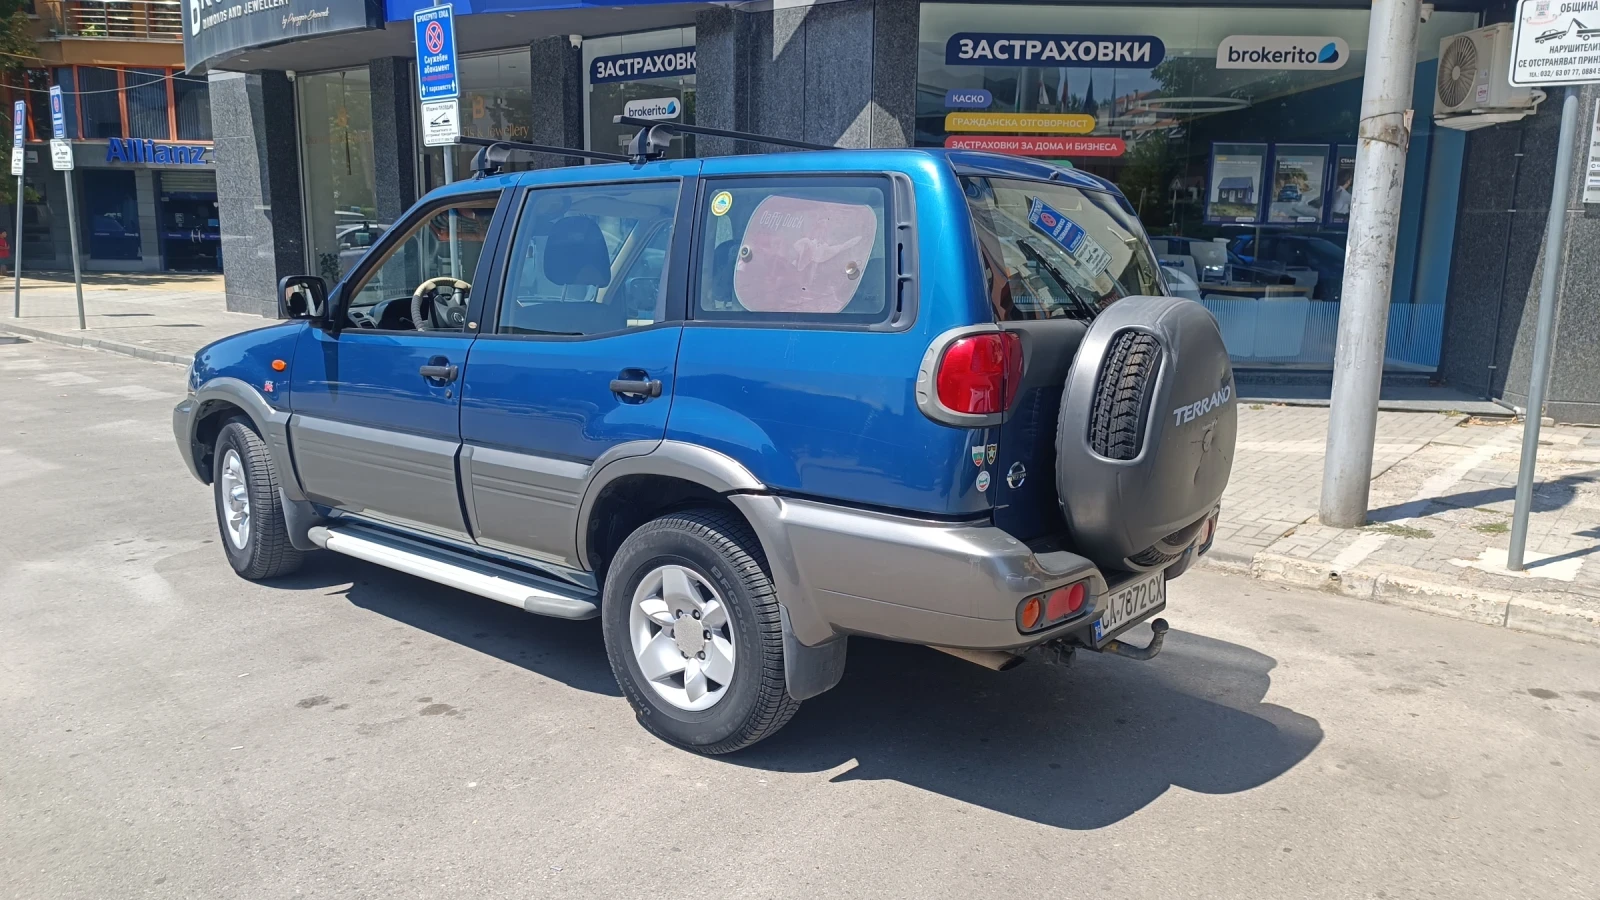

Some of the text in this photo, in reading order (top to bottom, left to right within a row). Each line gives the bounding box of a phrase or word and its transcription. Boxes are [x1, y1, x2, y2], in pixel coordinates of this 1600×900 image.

[228, 5, 242, 19] AND
[1560, 1, 1599, 13] ОБЩИНА
[958, 39, 1151, 62] ЗАСТРАХОВКИ
[1227, 45, 1317, 63] brokerito
[424, 53, 448, 65] Служебен
[1528, 57, 1577, 67] ОТСТРАНЯВАТ
[424, 64, 450, 74] абонамент
[952, 94, 985, 103] КАСКО
[628, 104, 667, 117] brokerito
[952, 117, 1088, 128] ГРАЖДАНСКА ОТГОВОРНОСТ
[106, 137, 207, 165] Allianz
[952, 140, 1118, 151] ЗАСТРАХОВКИ ЗА ДОМА И БИЗНЕСА
[760, 210, 782, 231] Daffy
[1173, 385, 1231, 427] TERRANO
[1118, 583, 1147, 621] 7872
[1148, 569, 1163, 604] CX
